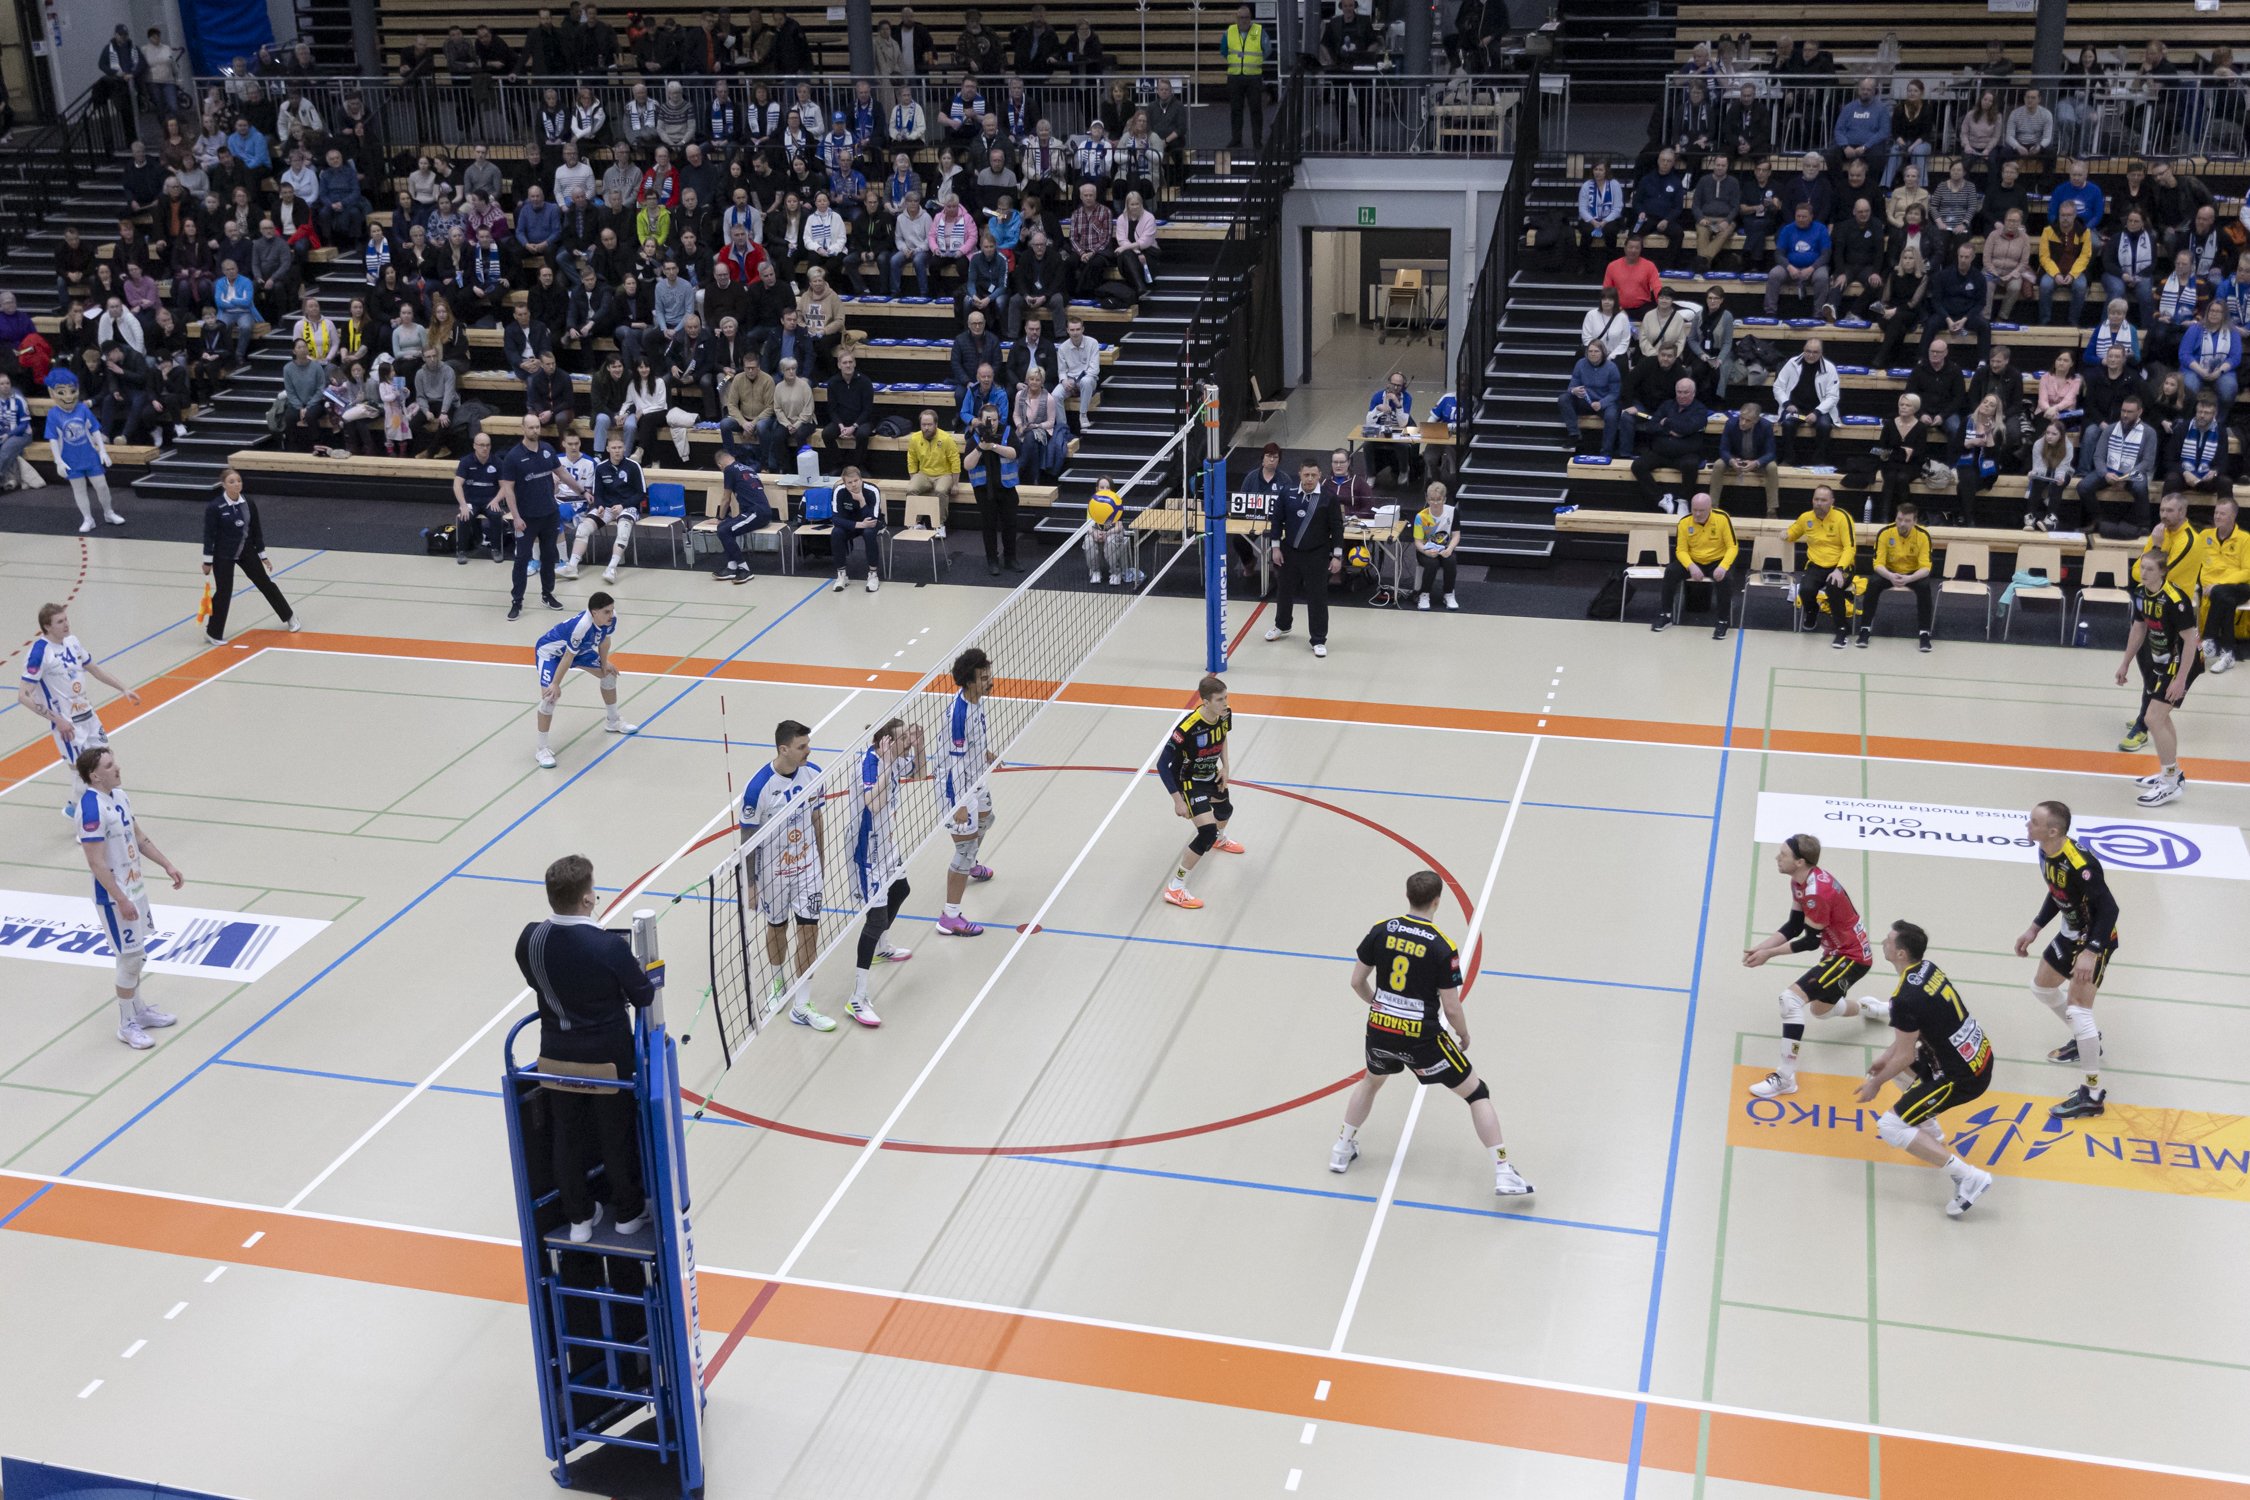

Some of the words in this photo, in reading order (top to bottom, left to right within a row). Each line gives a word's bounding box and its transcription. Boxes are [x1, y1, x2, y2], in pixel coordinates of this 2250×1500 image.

[1234, 496, 1243, 511] 9
[1249, 497, 1262, 508] 10
[543, 669, 551, 681] 5
[1210, 726, 1222, 744] 10
[115, 805, 130, 827] 2
[1824, 810, 1923, 828] Group
[1859, 825, 2036, 848] eomuovi
[123, 928, 135, 944] 2
[1386, 936, 1427, 958] BERG
[1389, 955, 1410, 991] 8
[1940, 984, 1964, 1021] 7
